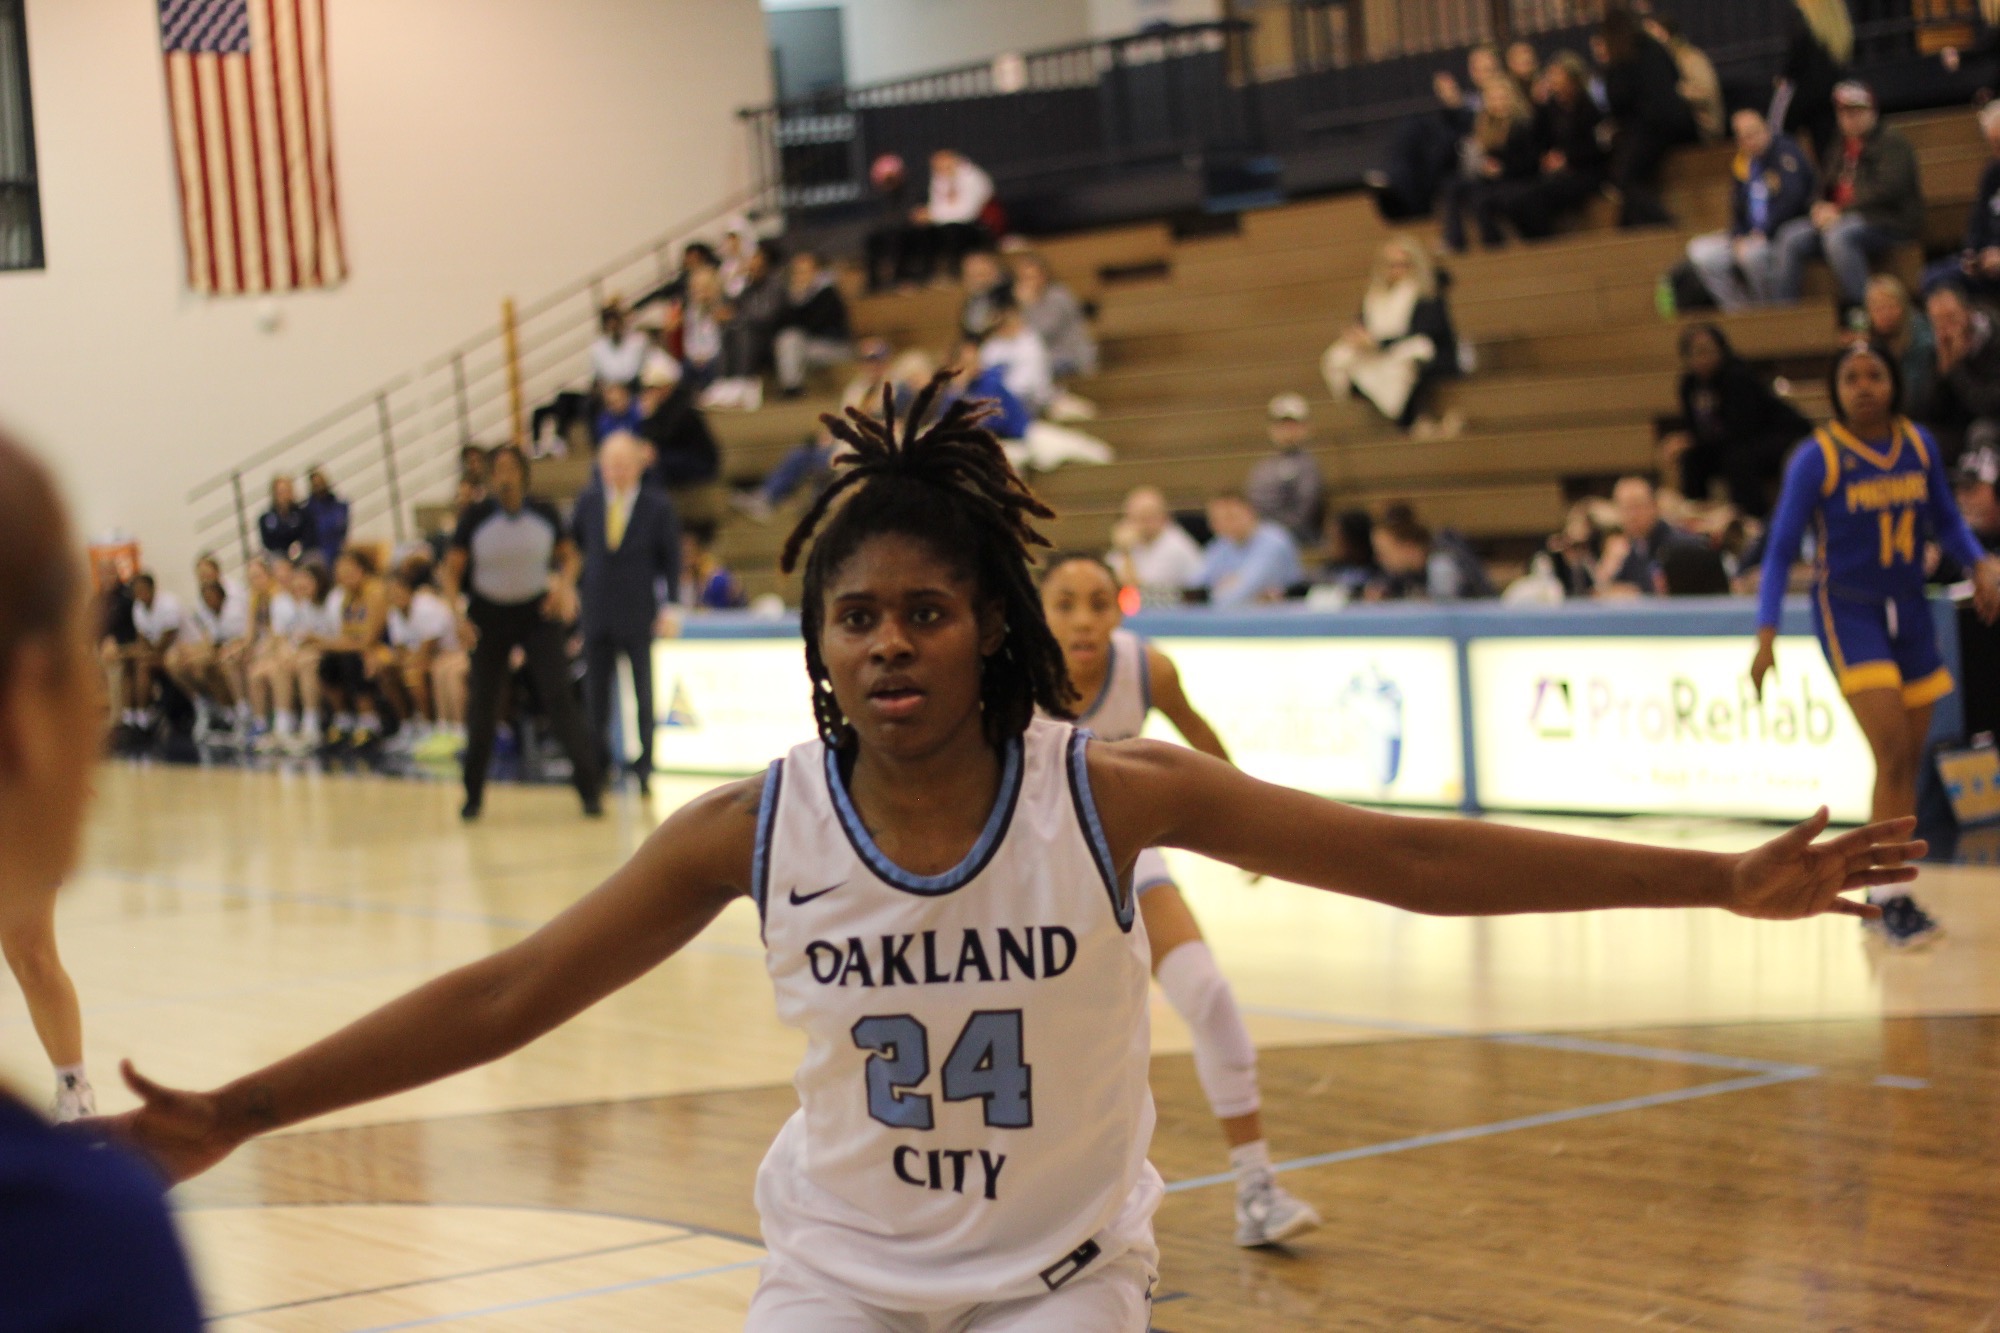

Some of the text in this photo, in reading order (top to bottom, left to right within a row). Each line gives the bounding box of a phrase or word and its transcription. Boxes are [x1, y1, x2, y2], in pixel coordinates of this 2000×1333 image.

[1879, 510, 1915, 568] 14
[1587, 674, 1835, 745] ProRehab
[805, 925, 1077, 987] OAKLAND
[850, 1008, 1034, 1131] 24
[893, 1145, 1007, 1200] CITY
